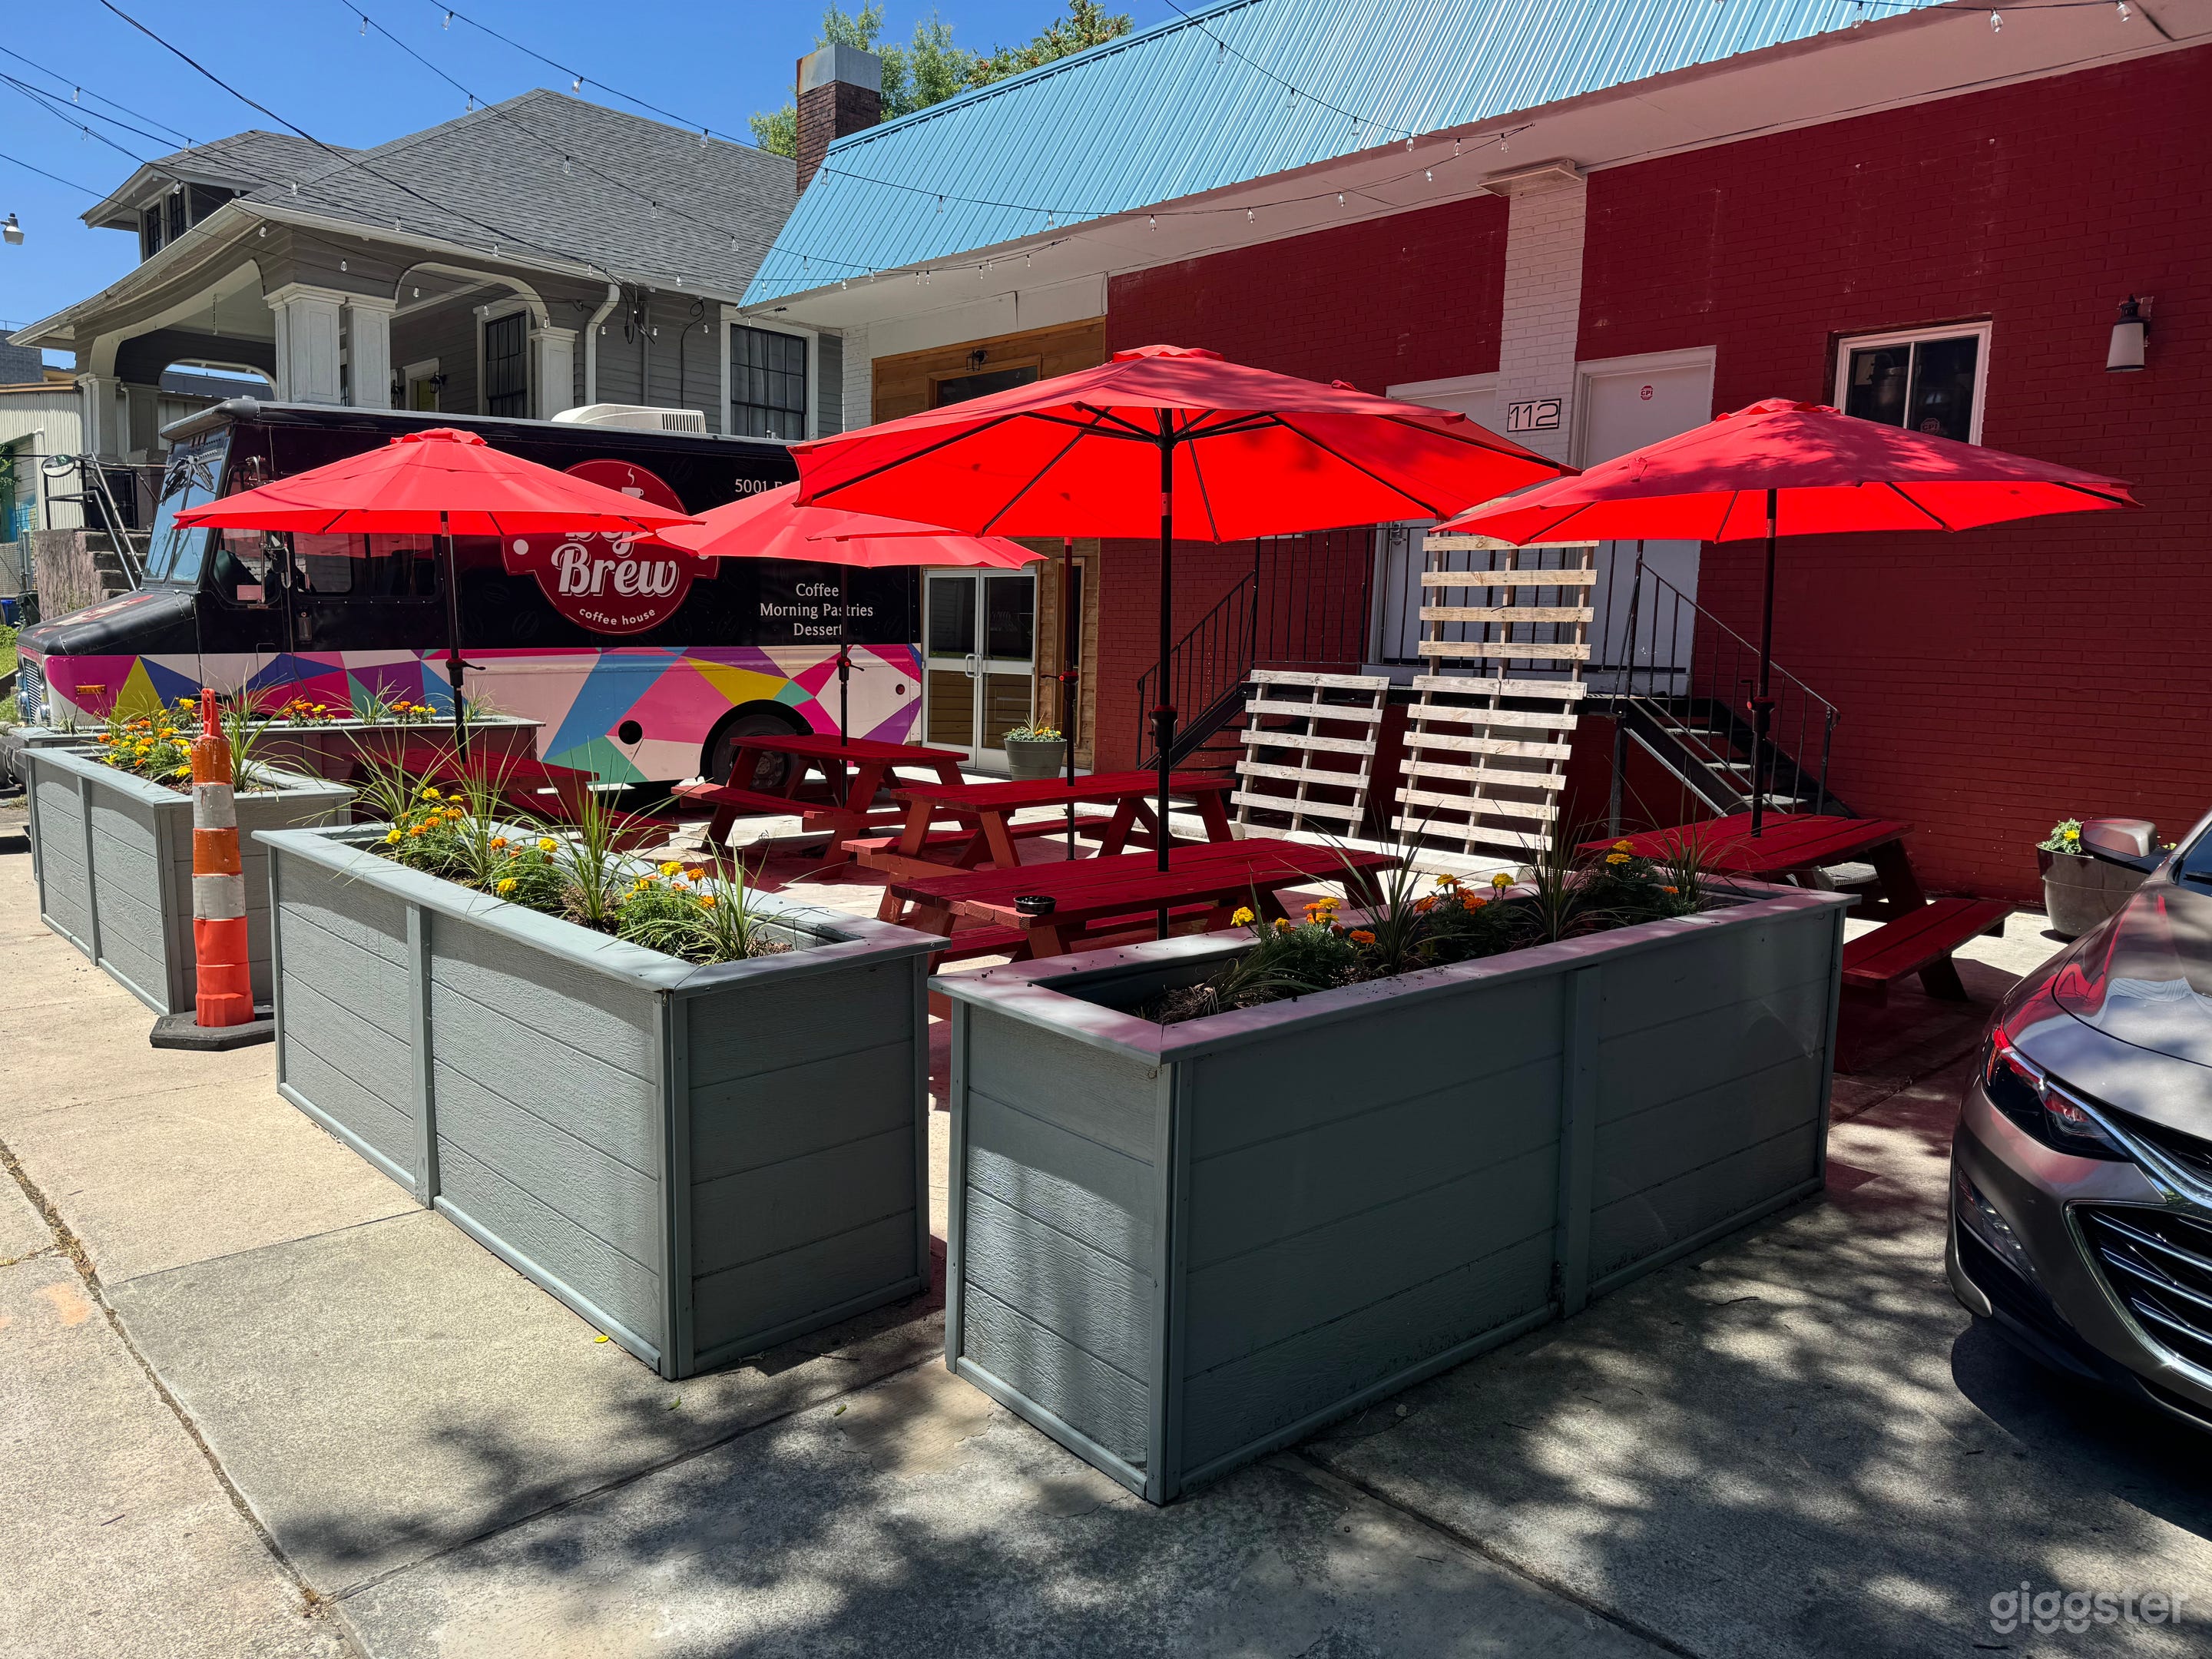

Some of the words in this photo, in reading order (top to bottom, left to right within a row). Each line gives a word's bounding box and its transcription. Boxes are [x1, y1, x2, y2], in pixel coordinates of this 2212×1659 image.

[1510, 403, 1558, 429] 112
[735, 478, 767, 493] 5001
[551, 542, 679, 597] Brew
[796, 583, 839, 596] Coffee
[579, 608, 618, 625] coffee
[621, 609, 656, 625] house
[760, 603, 818, 619] Morning
[793, 623, 842, 636] Dessert
